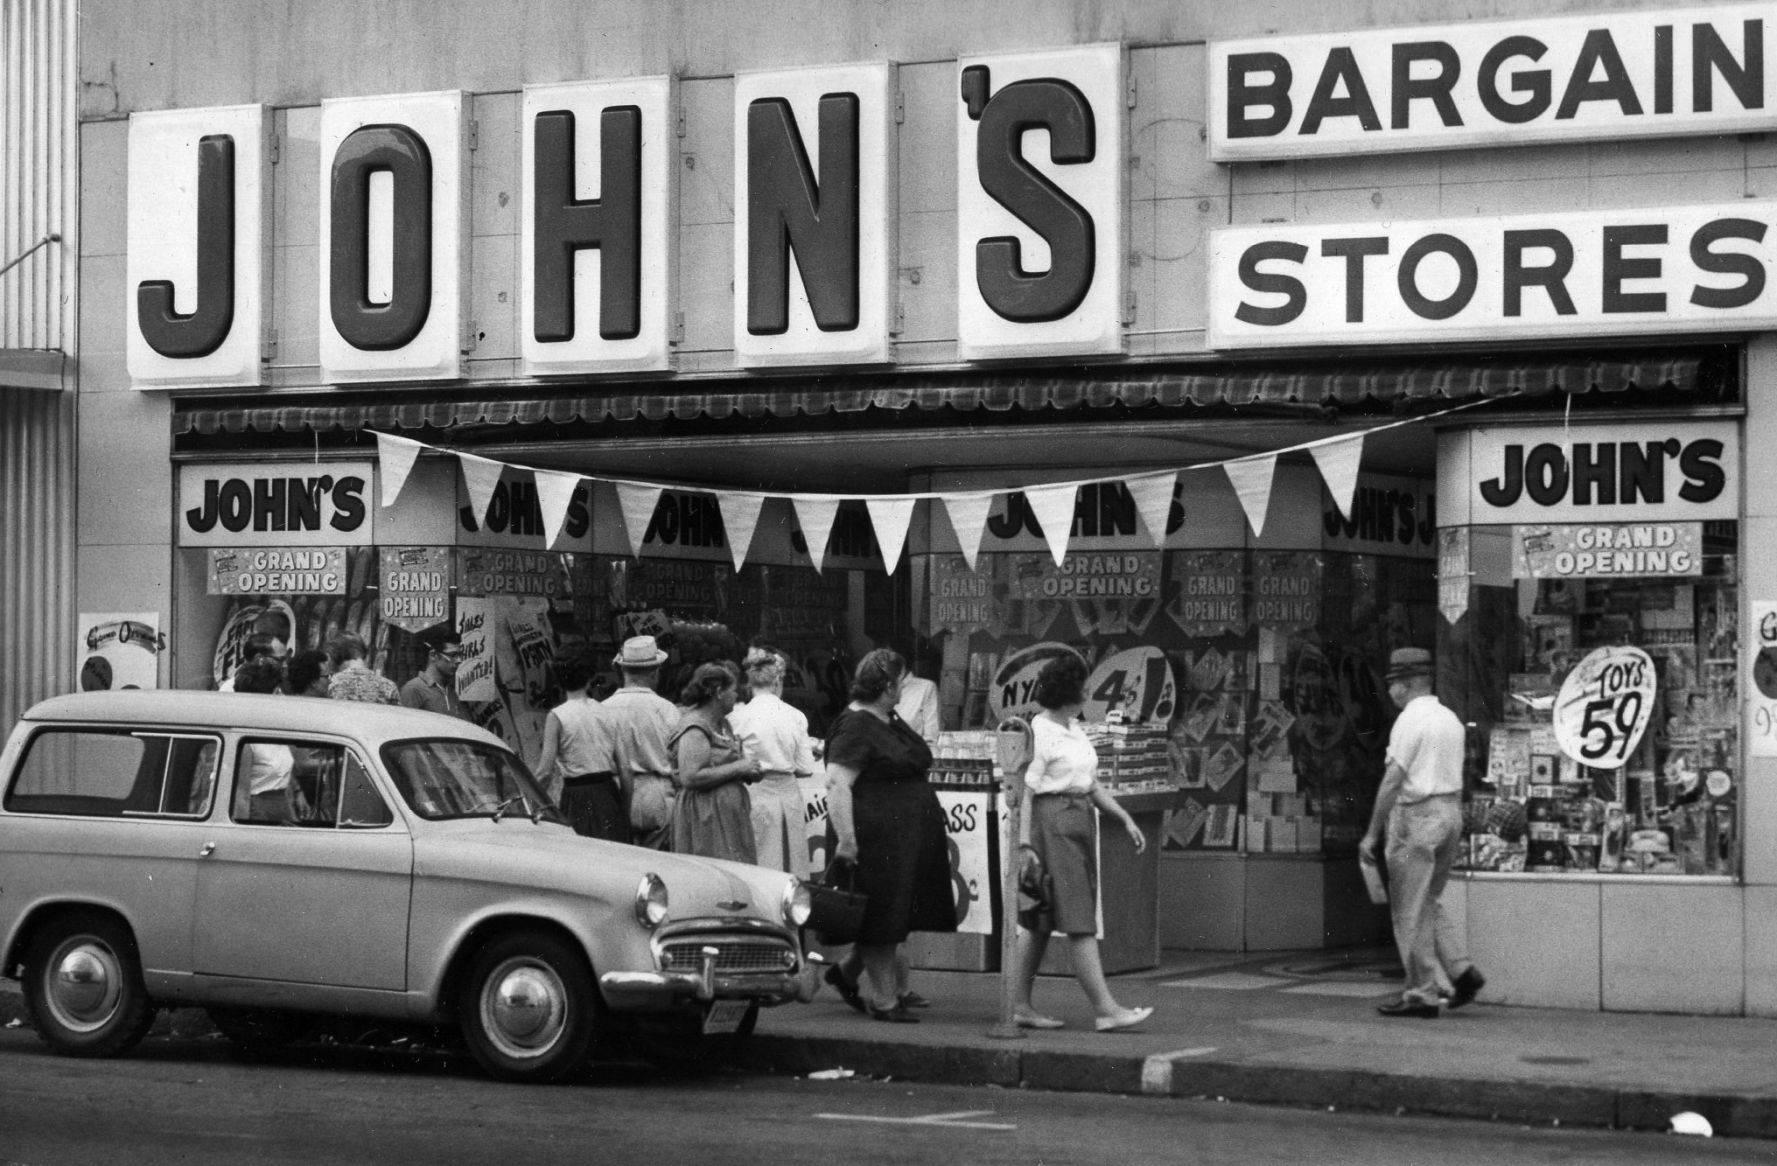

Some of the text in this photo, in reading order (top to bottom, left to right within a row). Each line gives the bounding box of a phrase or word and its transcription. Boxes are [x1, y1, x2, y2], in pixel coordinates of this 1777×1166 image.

[1226, 18, 1764, 139] BARGAIN
[137, 63, 1098, 359] JOHN'S
[1233, 217, 1769, 327] STORES
[1479, 438, 1726, 508] JOHN'S
[186, 474, 366, 533] JOHN'S
[460, 480, 589, 538] OHS
[643, 491, 724, 547] OHN
[1575, 525, 1676, 549] GRAND
[254, 551, 327, 571] GRAND
[495, 554, 547, 574] GRAND
[1061, 556, 1139, 575] GRAND
[1555, 549, 1692, 575] OPENING
[239, 573, 338, 592] OPENING
[387, 571, 442, 592] GRAND
[483, 574, 556, 594] OPENING
[941, 578, 986, 597] GRAND
[1043, 577, 1151, 596] OPENING
[1188, 576, 1236, 595] GRAND
[1260, 576, 1310, 595] GRAND
[384, 597, 444, 618] OPENING
[939, 602, 988, 622] OPENING
[1185, 601, 1238, 621] OPENING
[1257, 602, 1313, 621] OPENING
[459, 612, 485, 635] SALES
[1594, 658, 1647, 699] TOYS
[1580, 691, 1642, 760] 59
